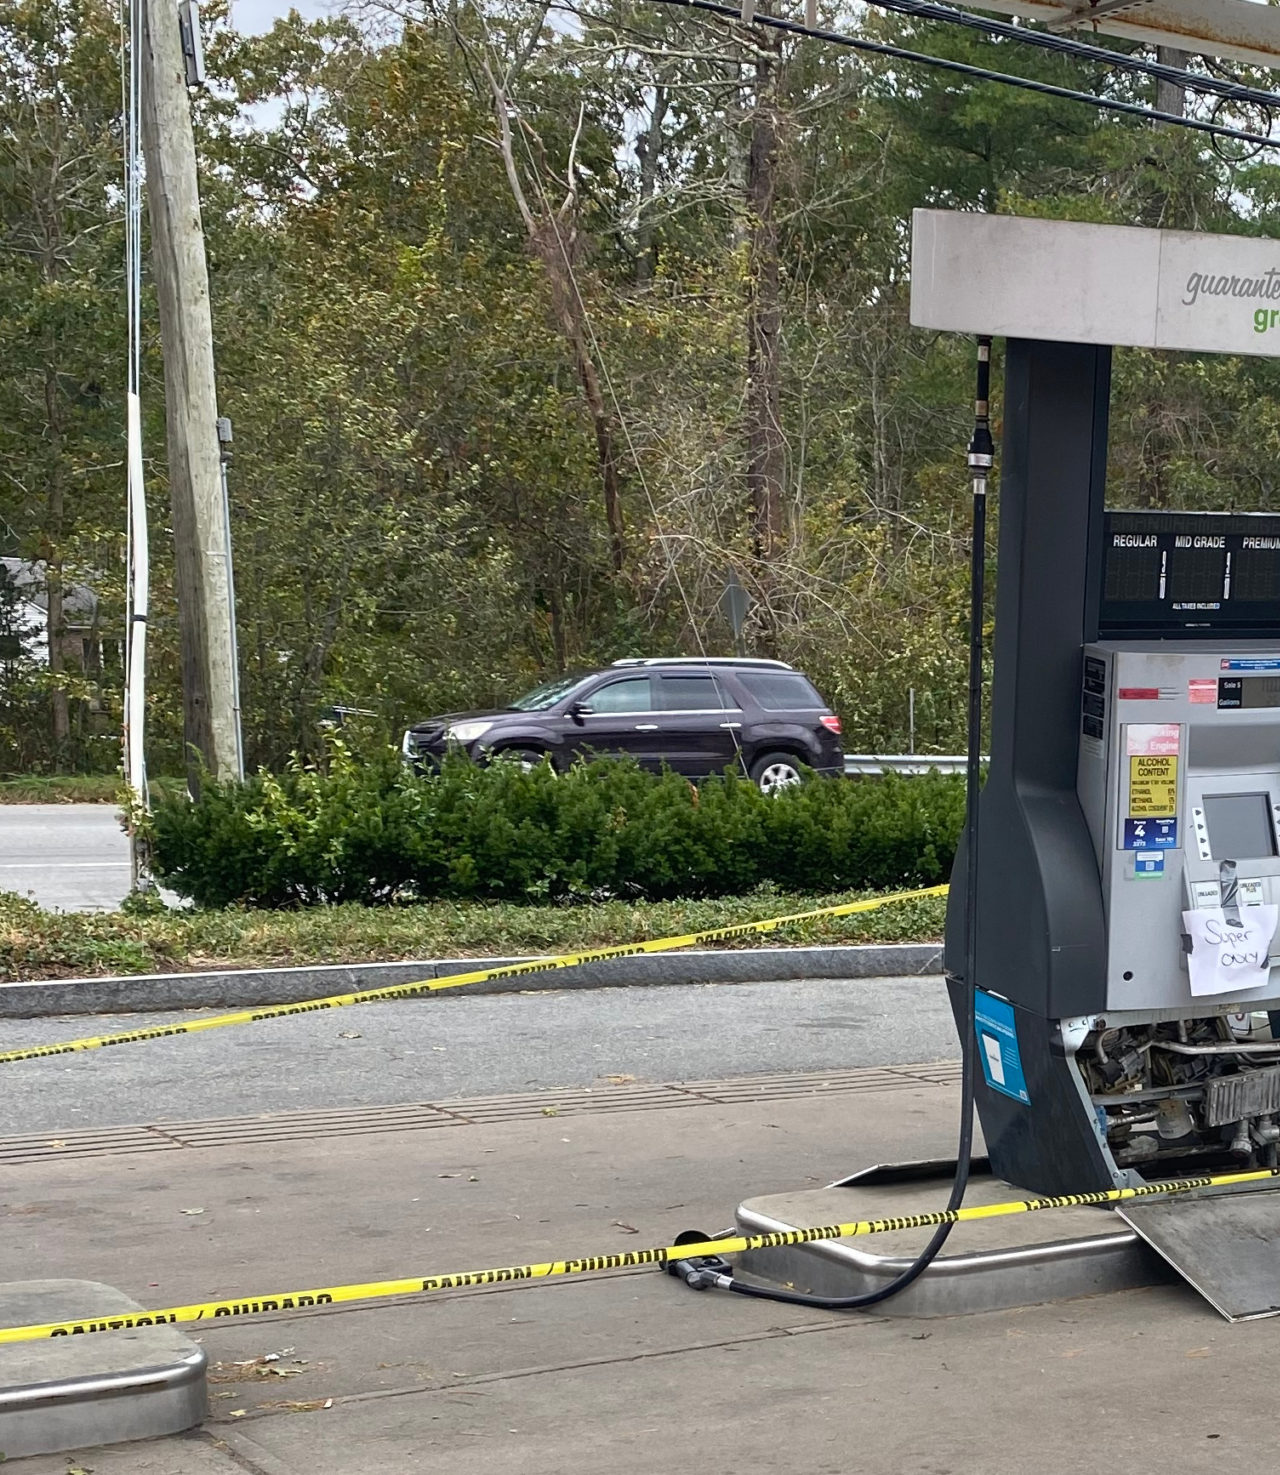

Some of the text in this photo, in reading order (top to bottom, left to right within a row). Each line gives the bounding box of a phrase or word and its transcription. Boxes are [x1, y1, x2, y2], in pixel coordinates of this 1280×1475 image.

[1113, 535, 1158, 547] REGULAR
[1175, 536, 1192, 548] MID
[1193, 536, 1226, 549] GRADE
[1138, 758, 1171, 766] ALCOHOL
[1138, 768, 1169, 776] CONTENT
[1134, 824, 1146, 837] 4
[1204, 919, 1253, 949] Super
